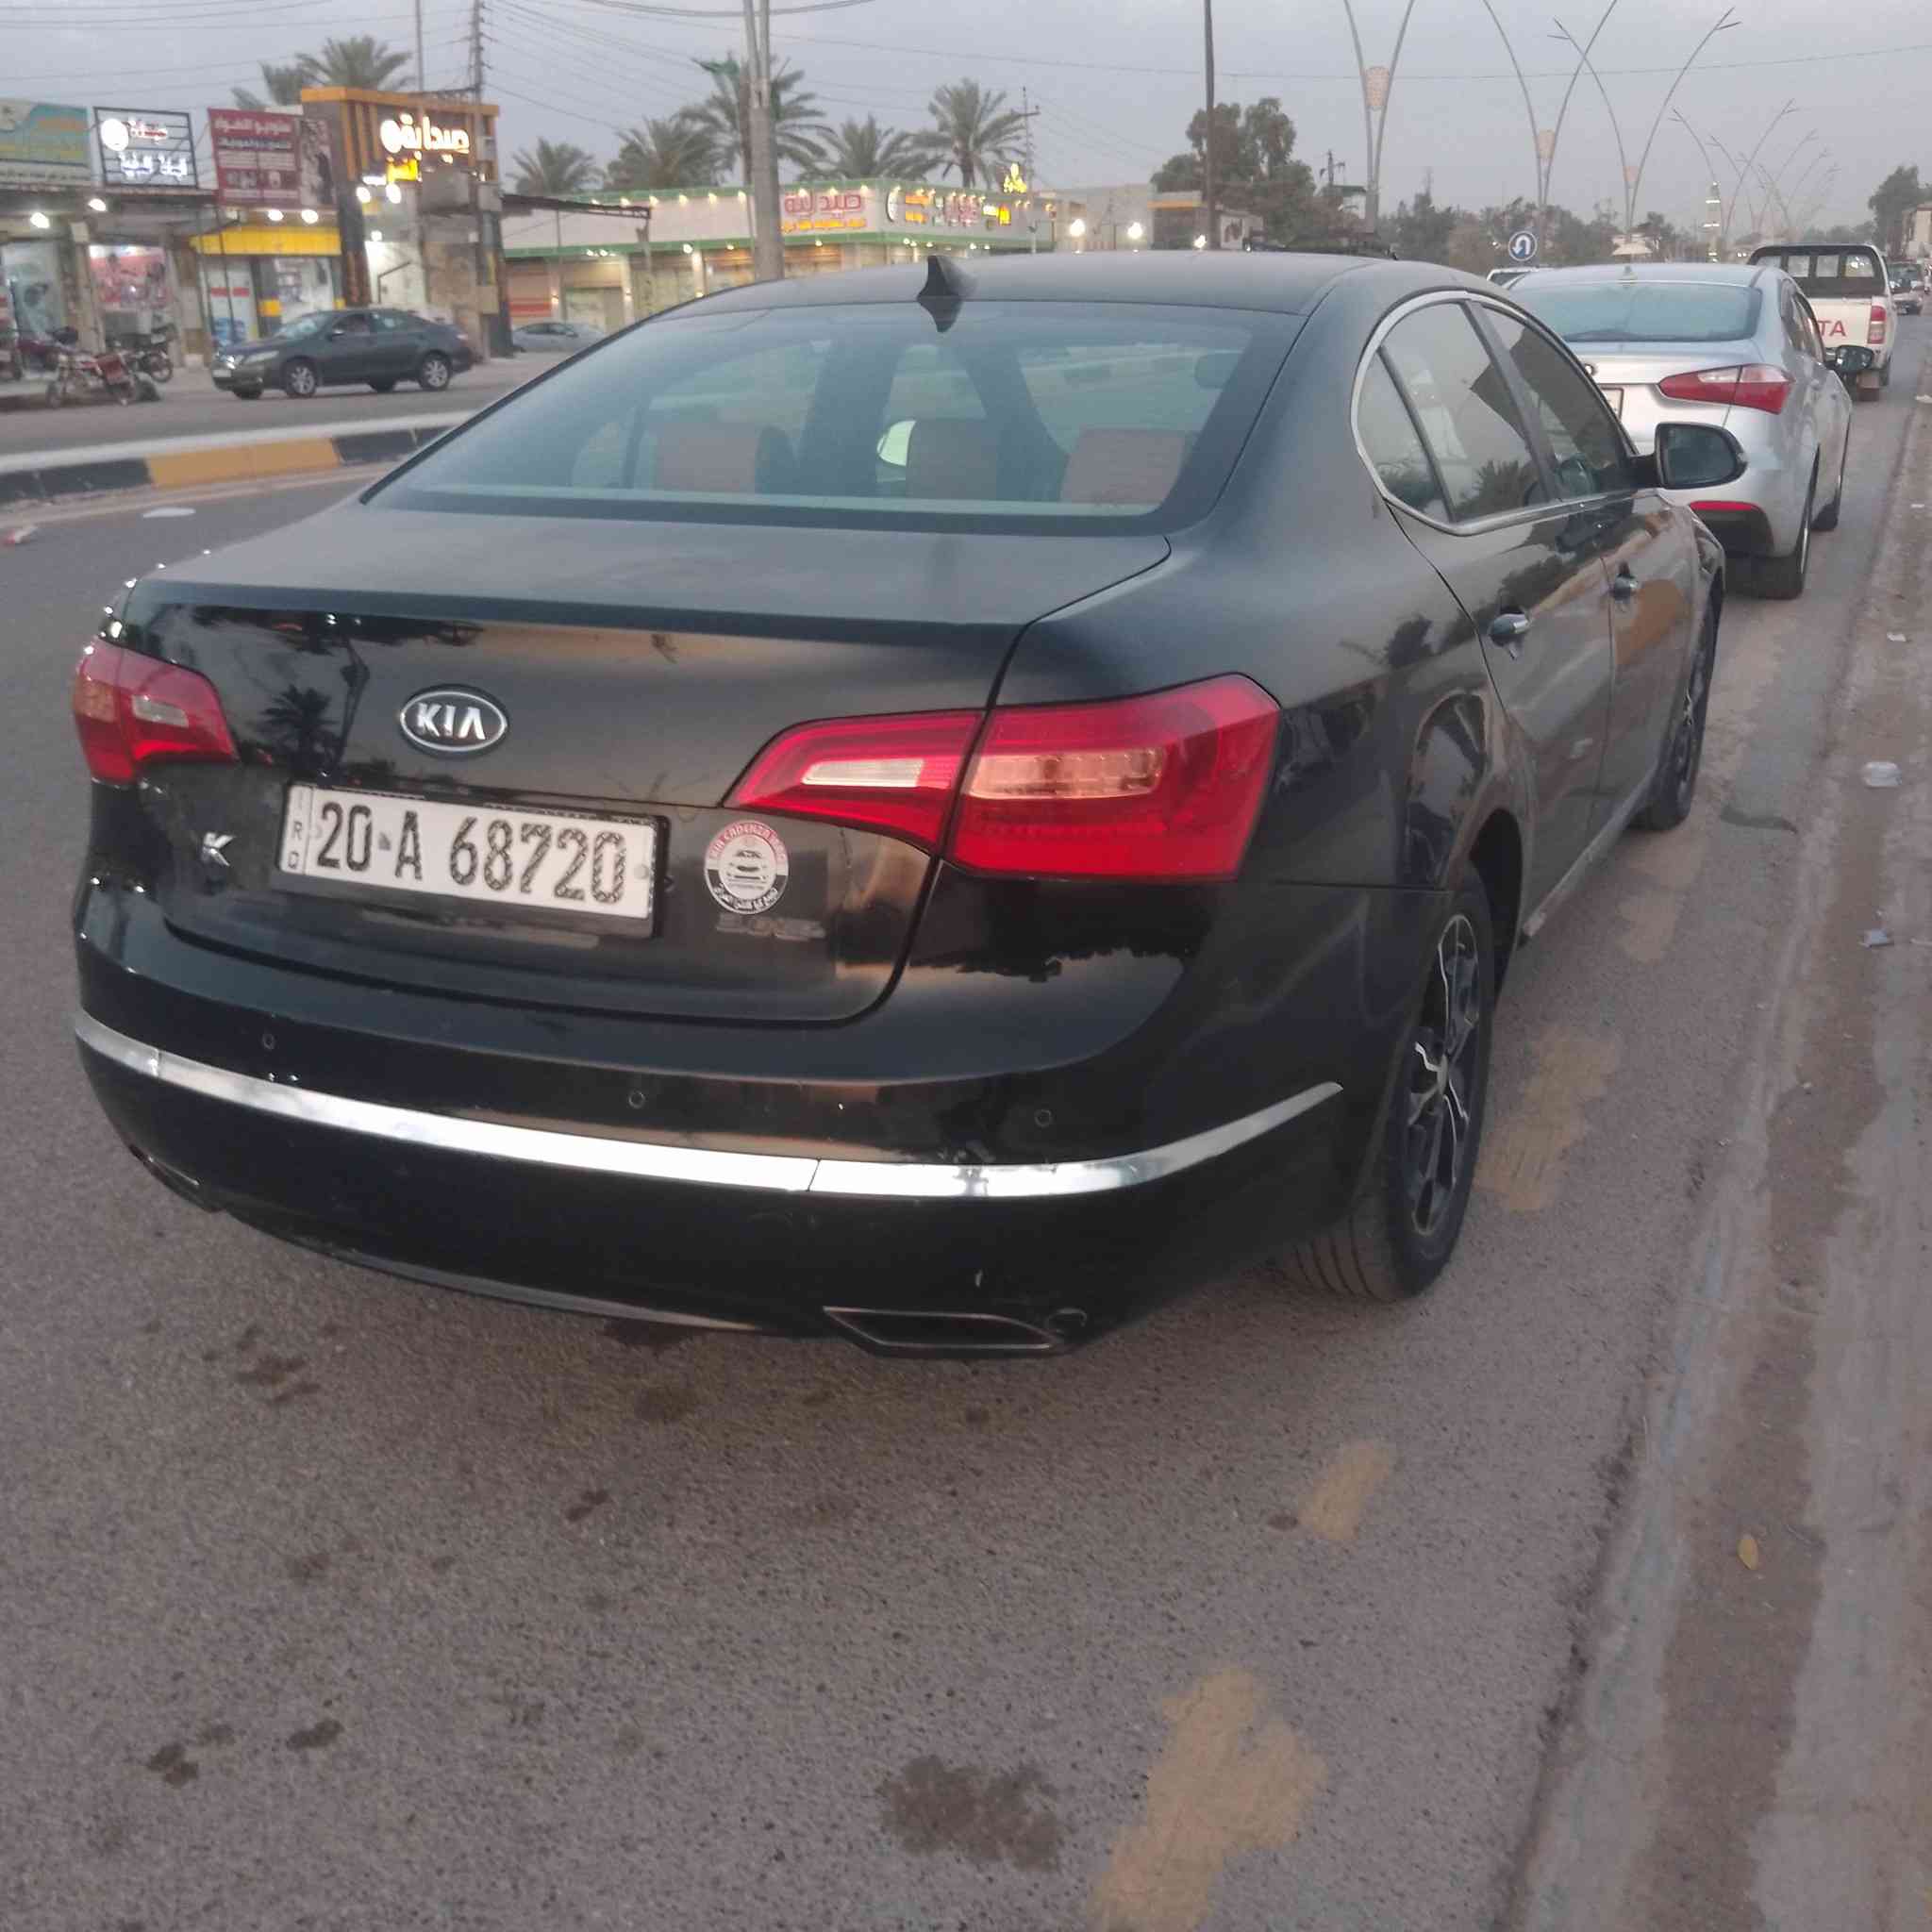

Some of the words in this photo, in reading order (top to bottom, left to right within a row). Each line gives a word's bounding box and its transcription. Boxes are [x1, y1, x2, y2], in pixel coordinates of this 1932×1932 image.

[417, 702, 487, 741] KIA
[317, 802, 373, 873] 20
[394, 810, 424, 880] A
[449, 816, 626, 905] 68720
